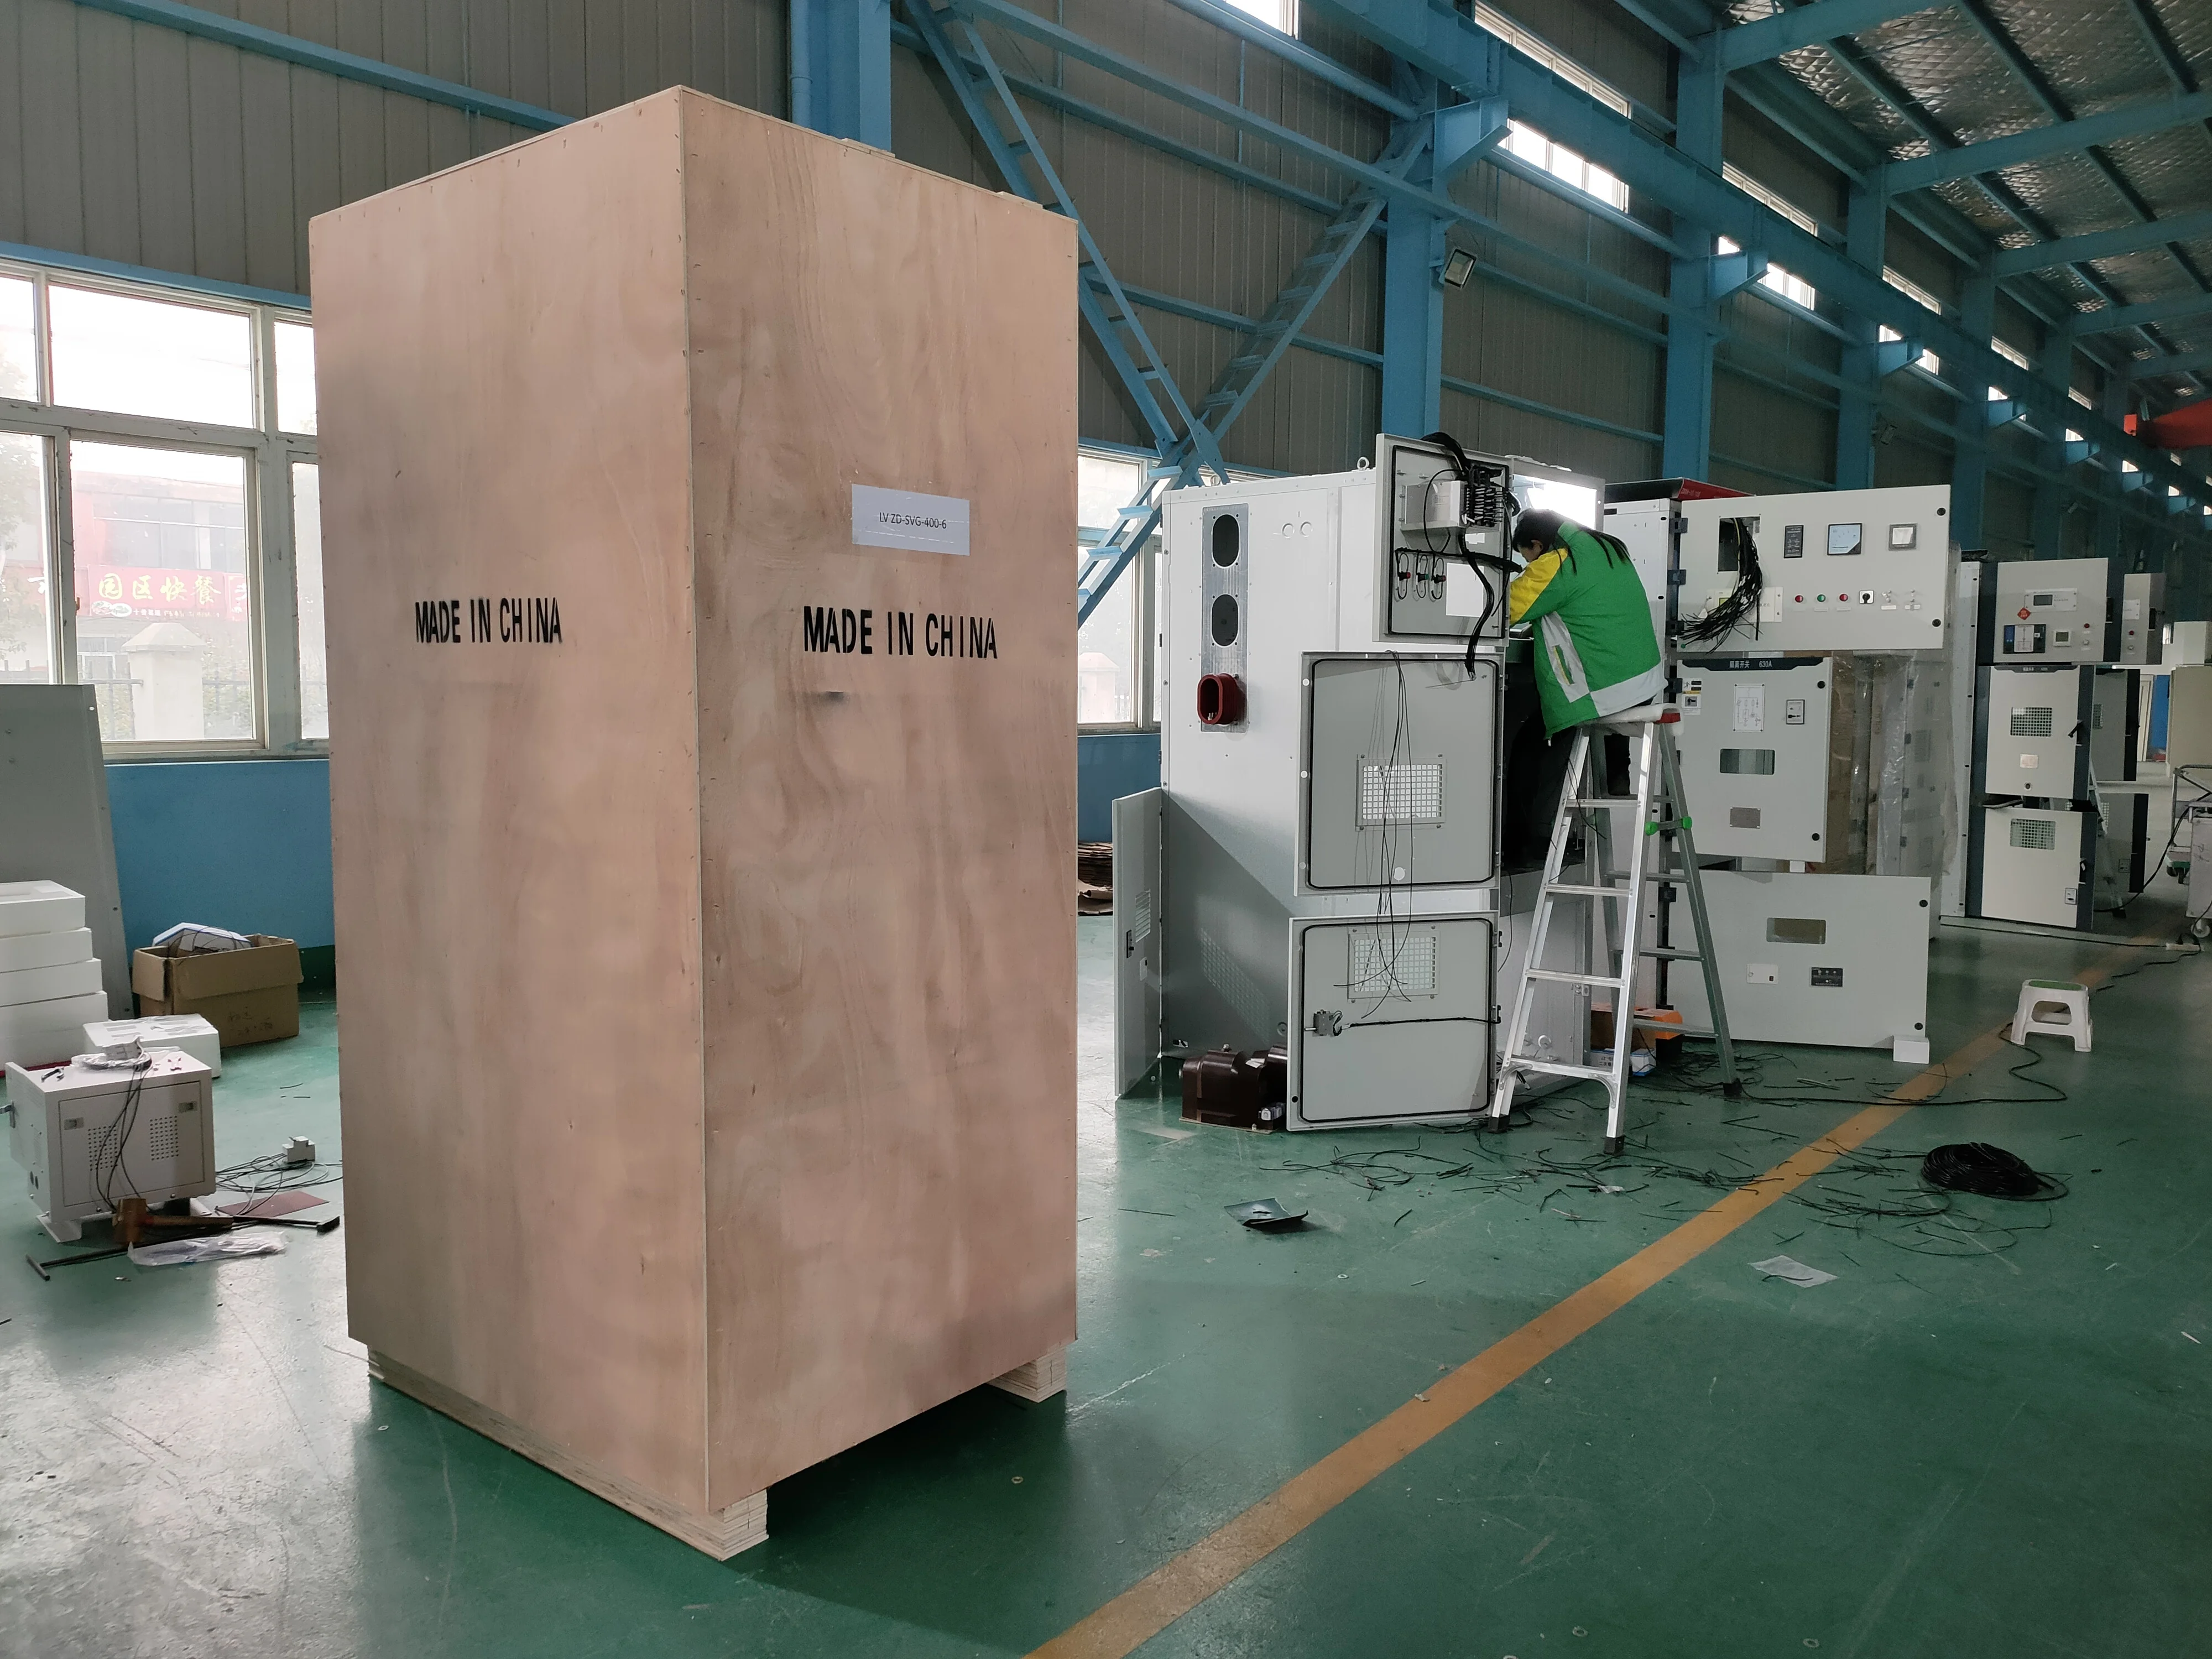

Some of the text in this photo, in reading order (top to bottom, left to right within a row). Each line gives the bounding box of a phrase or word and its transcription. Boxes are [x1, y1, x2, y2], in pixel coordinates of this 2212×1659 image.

[879, 512, 947, 529] LV ZD-SVG-400-6
[98, 572, 222, 605] 园区快餐
[415, 597, 563, 644] MADE IN CHINA
[804, 606, 998, 659] MADE IN CHINA
